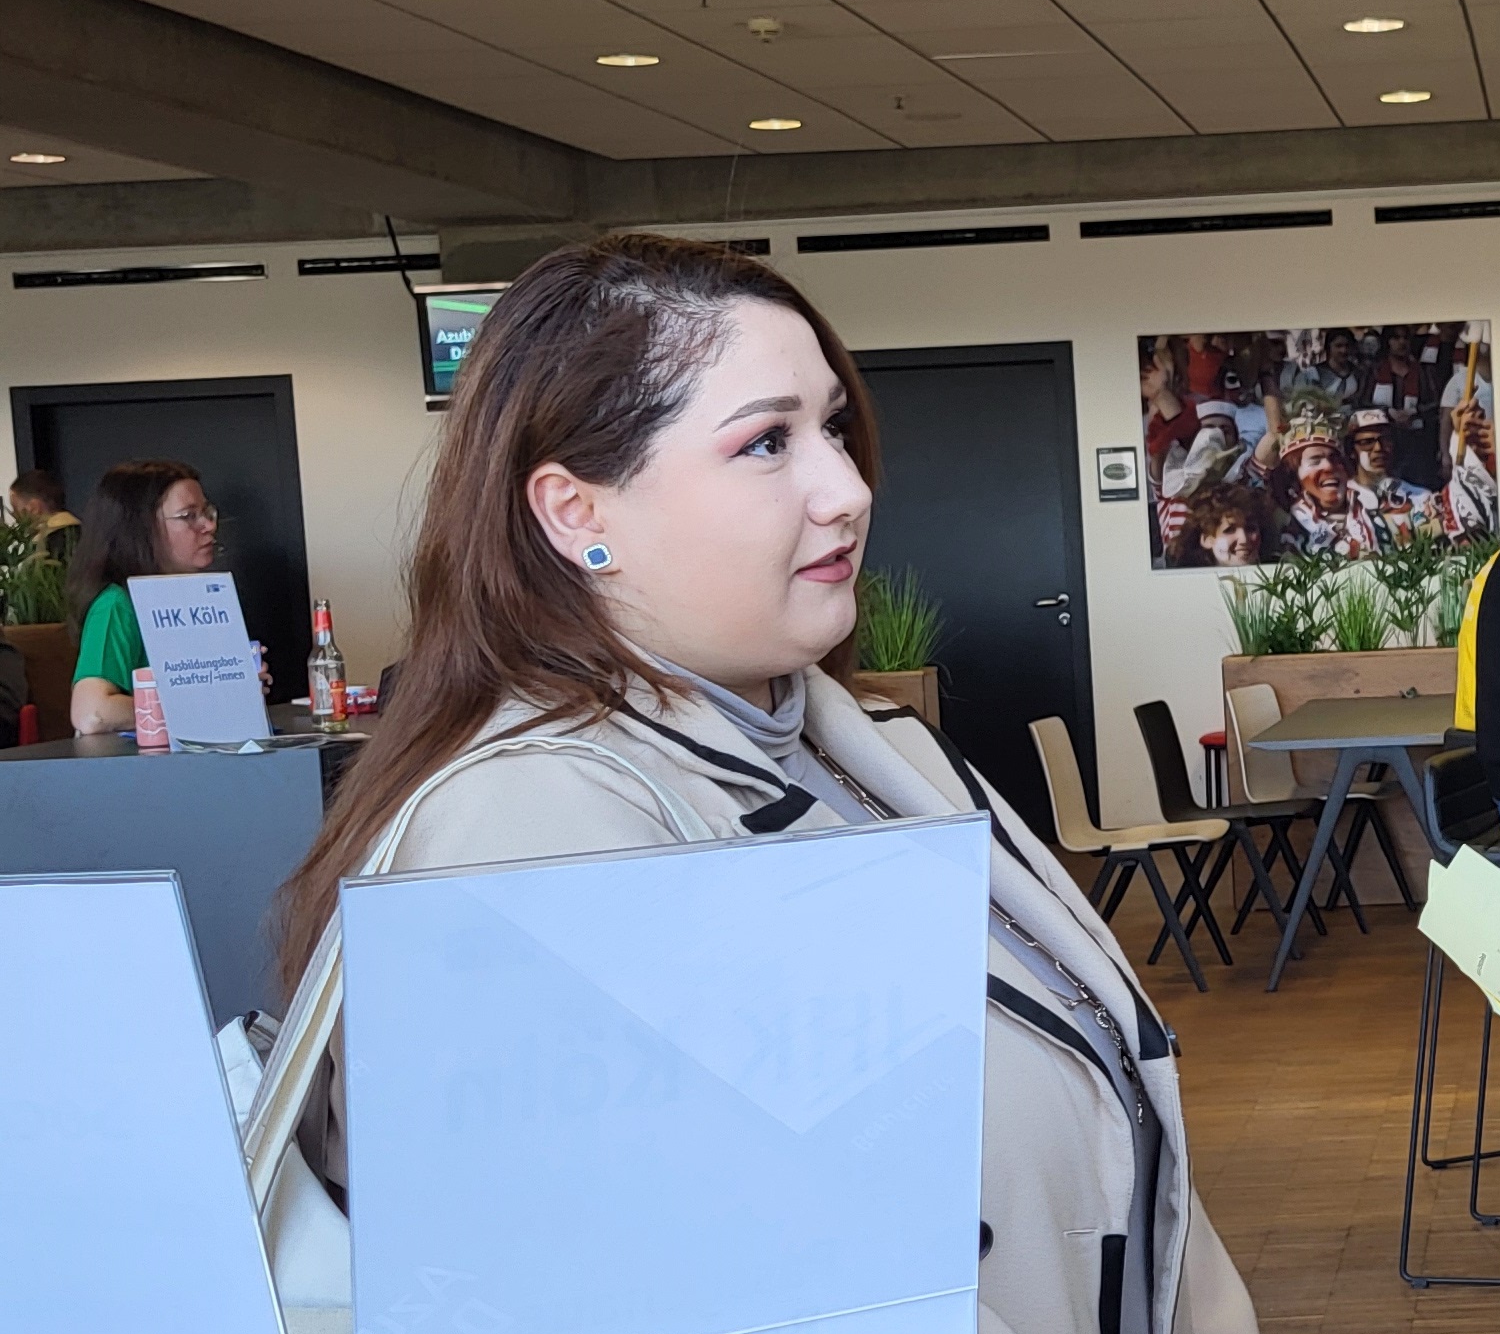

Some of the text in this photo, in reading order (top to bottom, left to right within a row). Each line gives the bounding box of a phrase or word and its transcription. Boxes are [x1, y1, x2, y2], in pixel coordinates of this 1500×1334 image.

[152, 605, 230, 629] IHK Köln
[163, 656, 244, 673] Ausbildungsbot-
